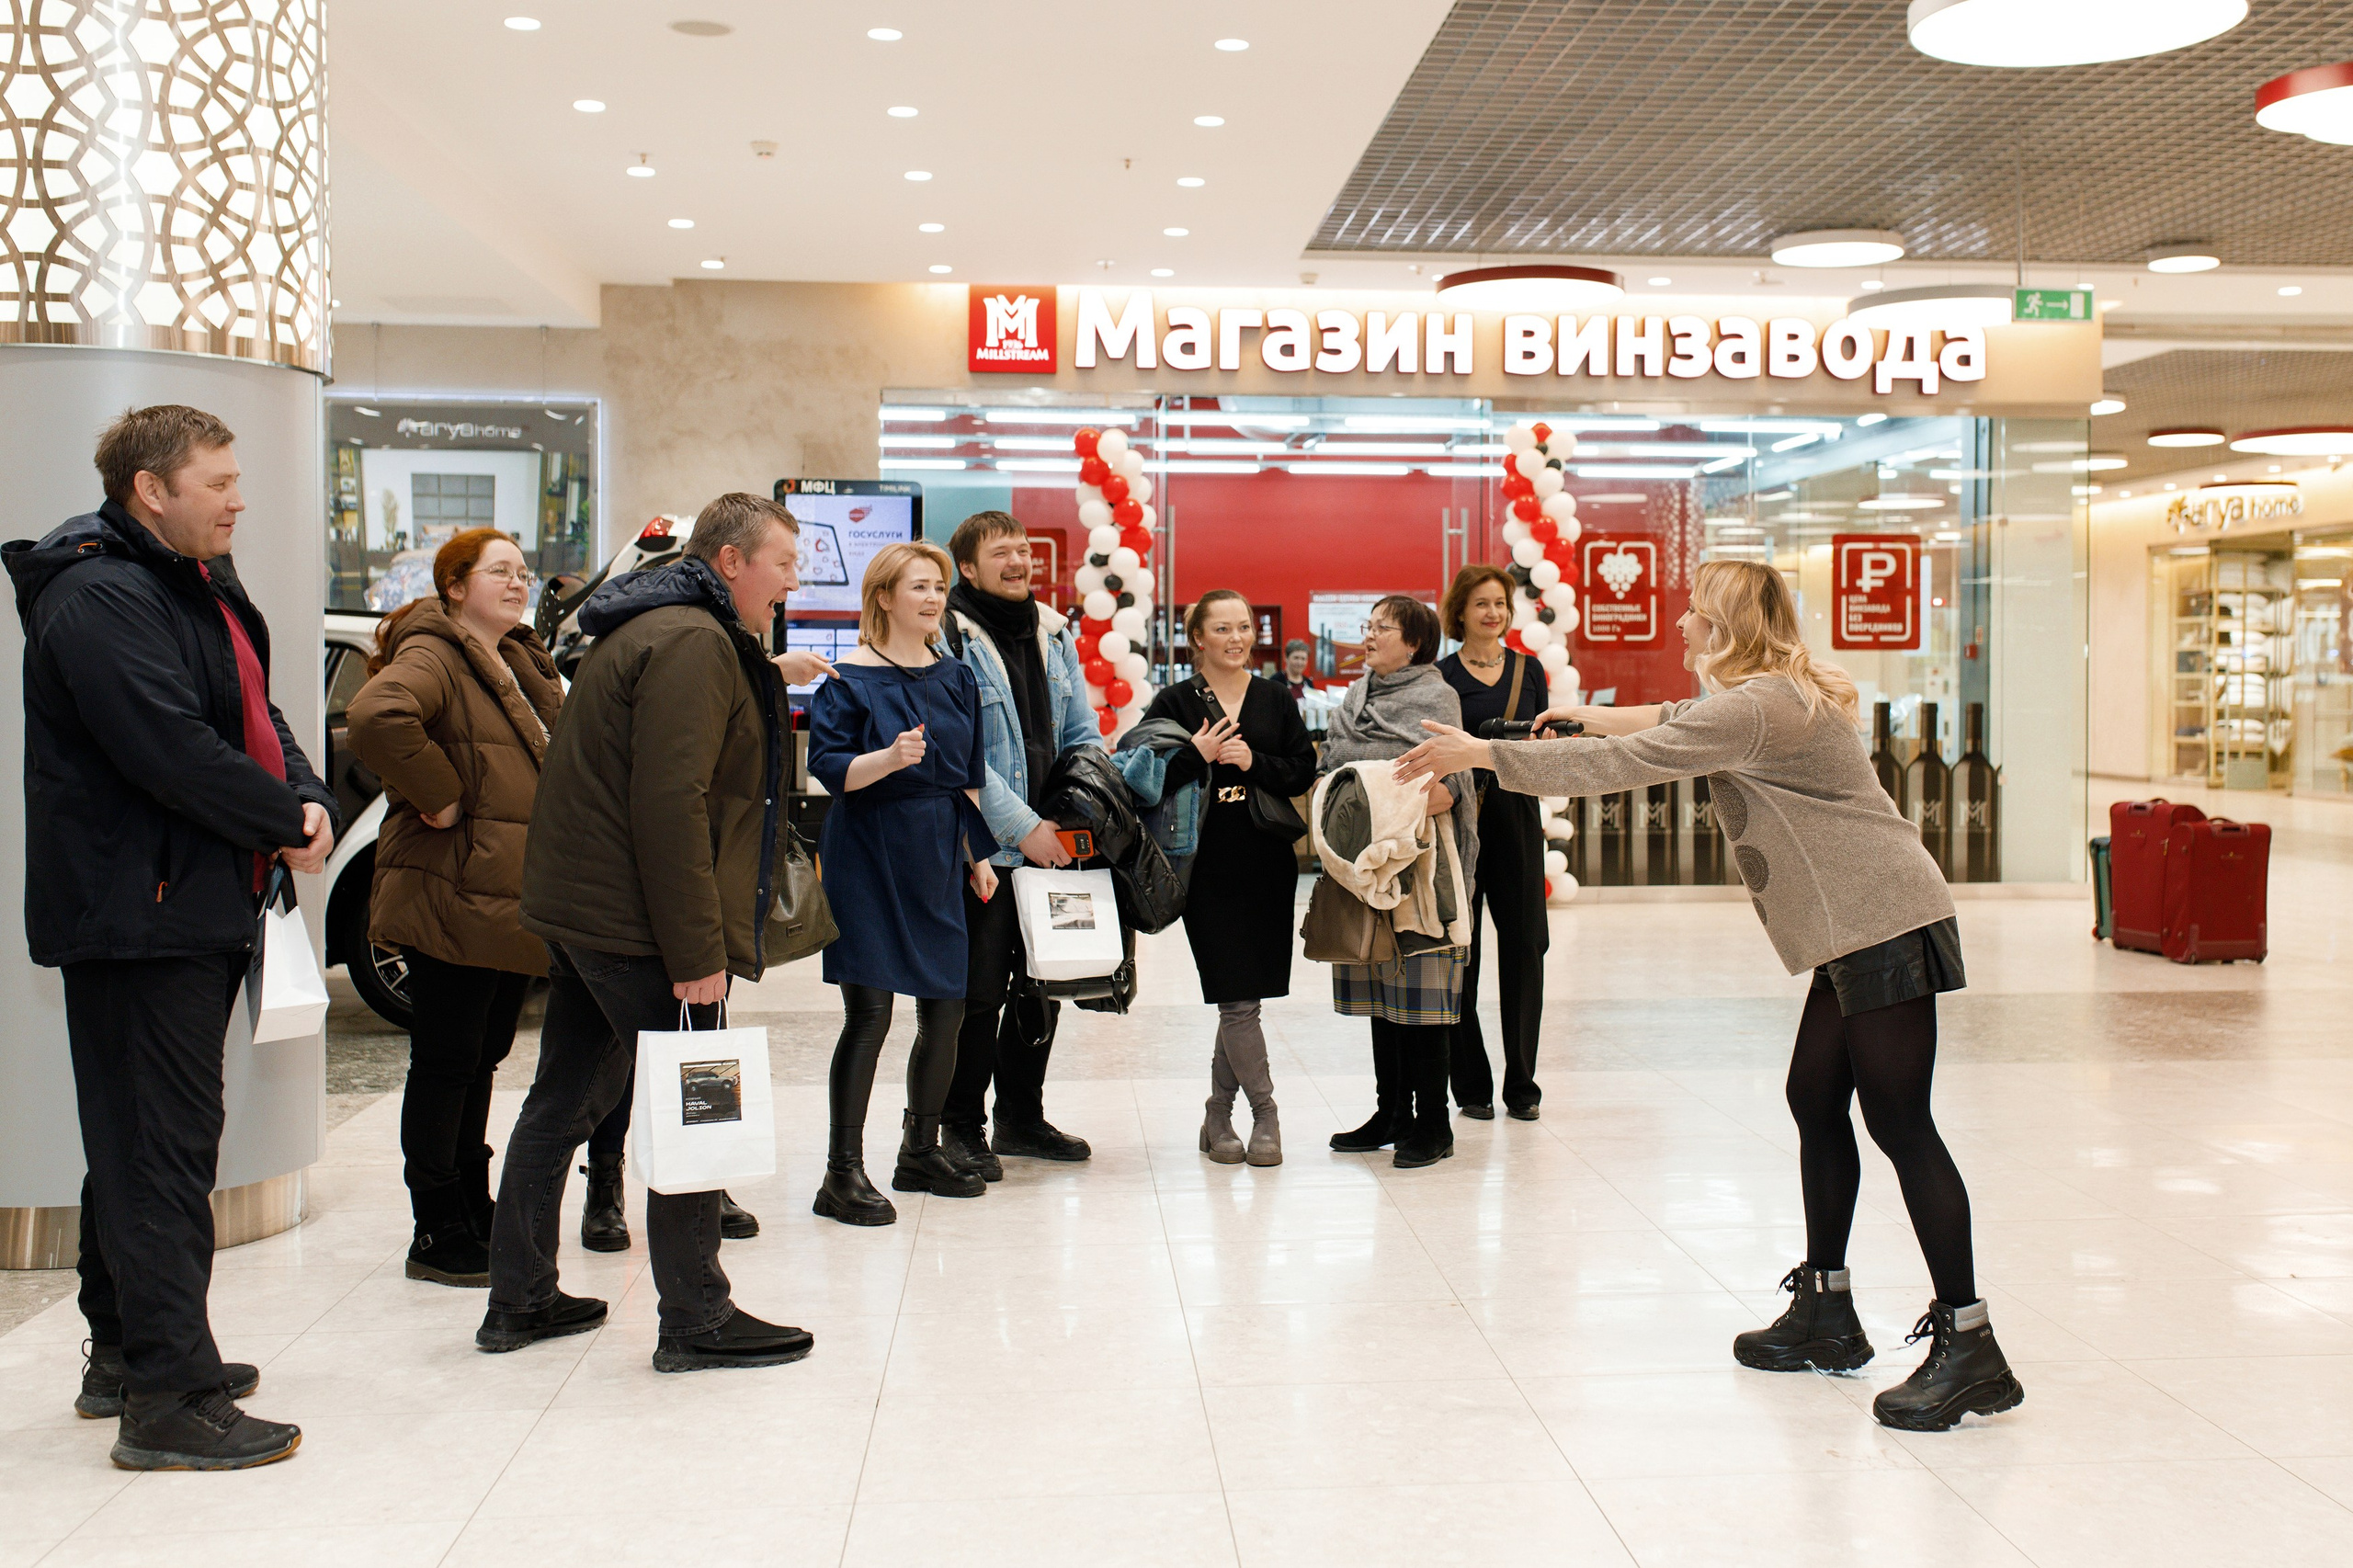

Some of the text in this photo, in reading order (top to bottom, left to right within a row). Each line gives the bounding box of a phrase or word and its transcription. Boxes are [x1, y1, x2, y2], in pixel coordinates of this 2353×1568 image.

[1074, 290, 1987, 394] Магазин винзавода
[975, 347, 1050, 361] MILLSTREAM
[801, 481, 835, 494] МФЦ
[848, 529, 904, 540] ГОСУСЛУГИ
[1848, 604, 1891, 614] ВИНЗАВОДА
[1848, 622, 1904, 632] ПОСРЕДНИКОВ
